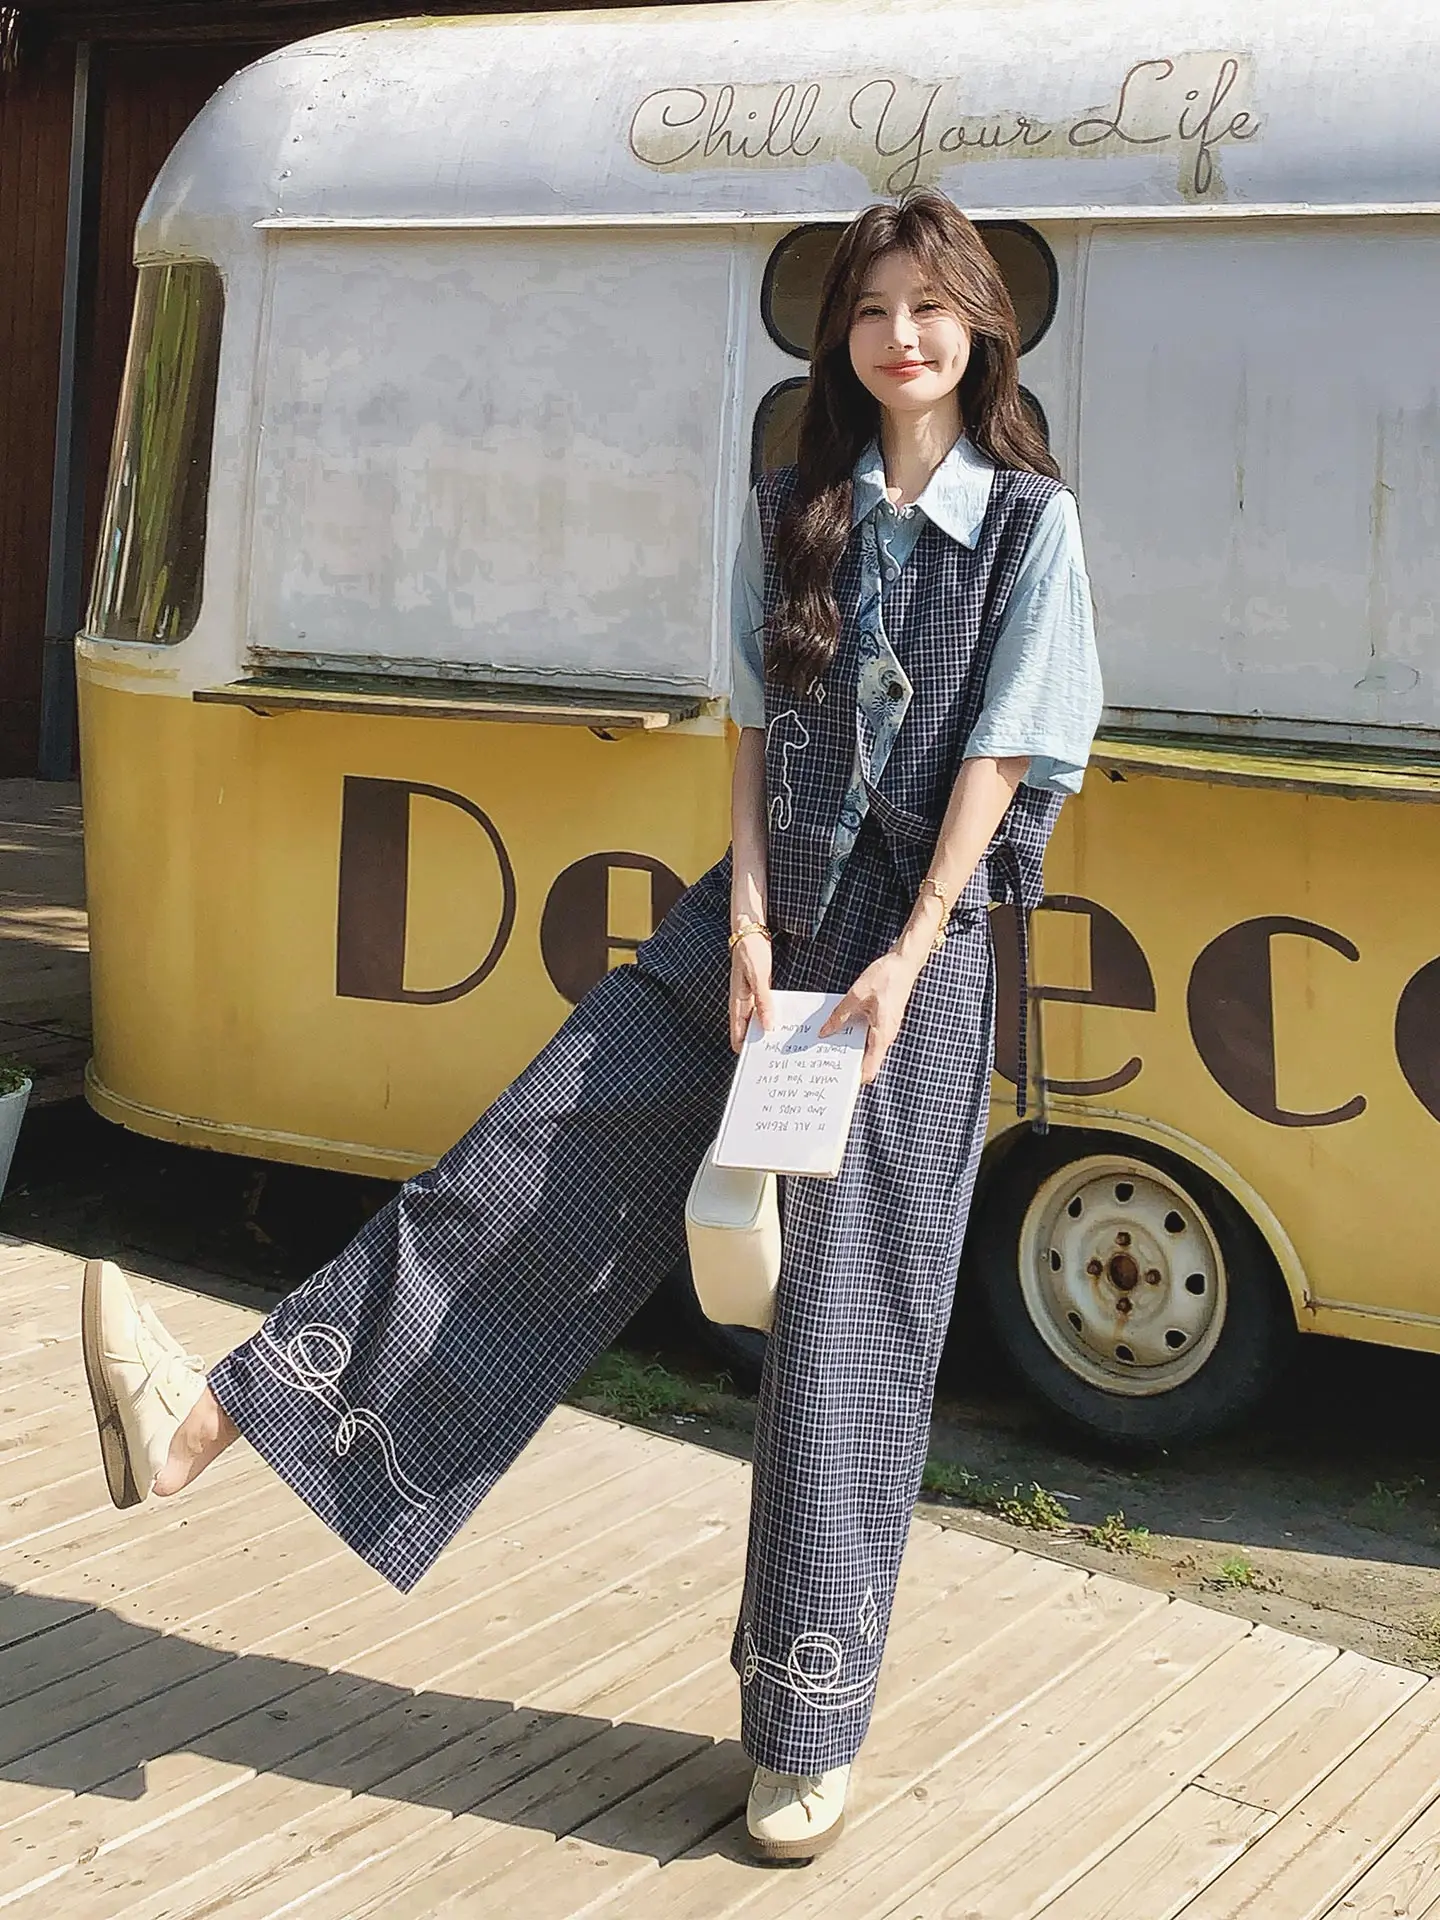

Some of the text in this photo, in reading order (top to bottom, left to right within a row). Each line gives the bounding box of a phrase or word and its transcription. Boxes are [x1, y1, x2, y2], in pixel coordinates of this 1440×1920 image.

[630, 58, 1261, 195] Chill Your Life
[781, 1025, 811, 1034] ALLOW
[816, 1045, 846, 1054] POWER
[768, 1060, 789, 1069] HAS
[810, 1060, 842, 1070] POWER
[756, 1075, 779, 1084] GIVE
[809, 1076, 838, 1084] WHAT
[779, 1105, 801, 1114] ENDS
[807, 1105, 827, 1116] AND
[755, 1121, 825, 1131] IT ALL BEGINS
